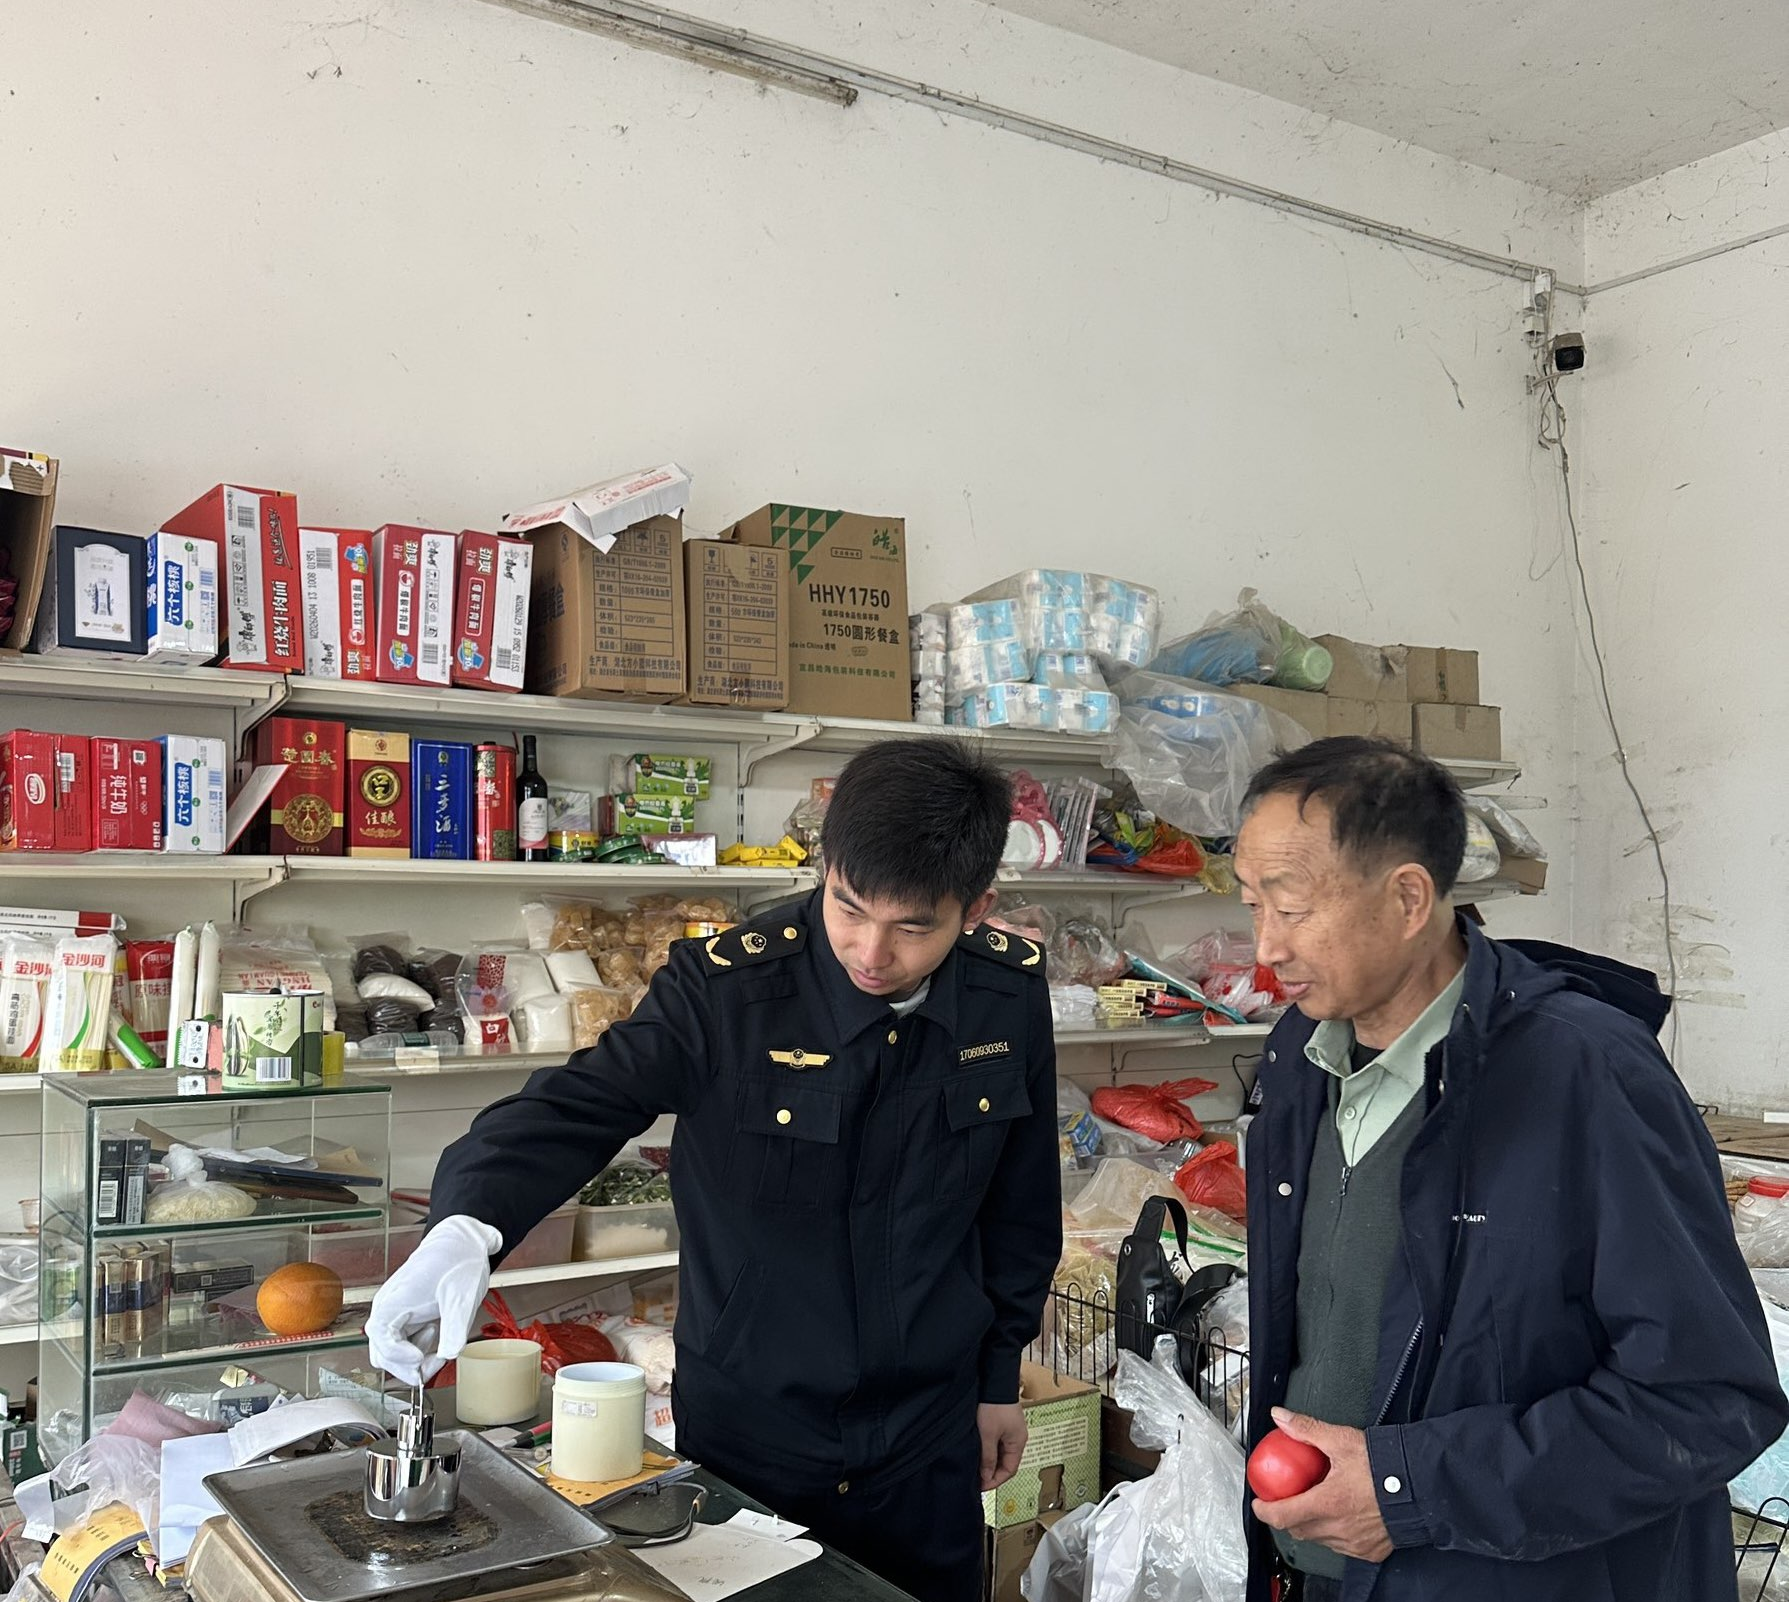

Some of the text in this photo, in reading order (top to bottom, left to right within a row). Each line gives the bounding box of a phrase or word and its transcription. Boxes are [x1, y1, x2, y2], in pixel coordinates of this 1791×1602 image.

[404, 541, 418, 566] 劲爽
[478, 547, 493, 573] 劲爽
[167, 564, 181, 622] 六个核桃
[809, 583, 890, 609] HHY1750
[271, 580, 289, 657] 红烧牛肉面
[823, 623, 900, 645] 1750圆形餐盒
[347, 650, 360, 675] 劲爽
[109, 774, 128, 815] 纯牛奶
[176, 766, 190, 823] 六个核桃
[365, 810, 397, 826] 佳酿
[62, 953, 106, 968] 金沙河
